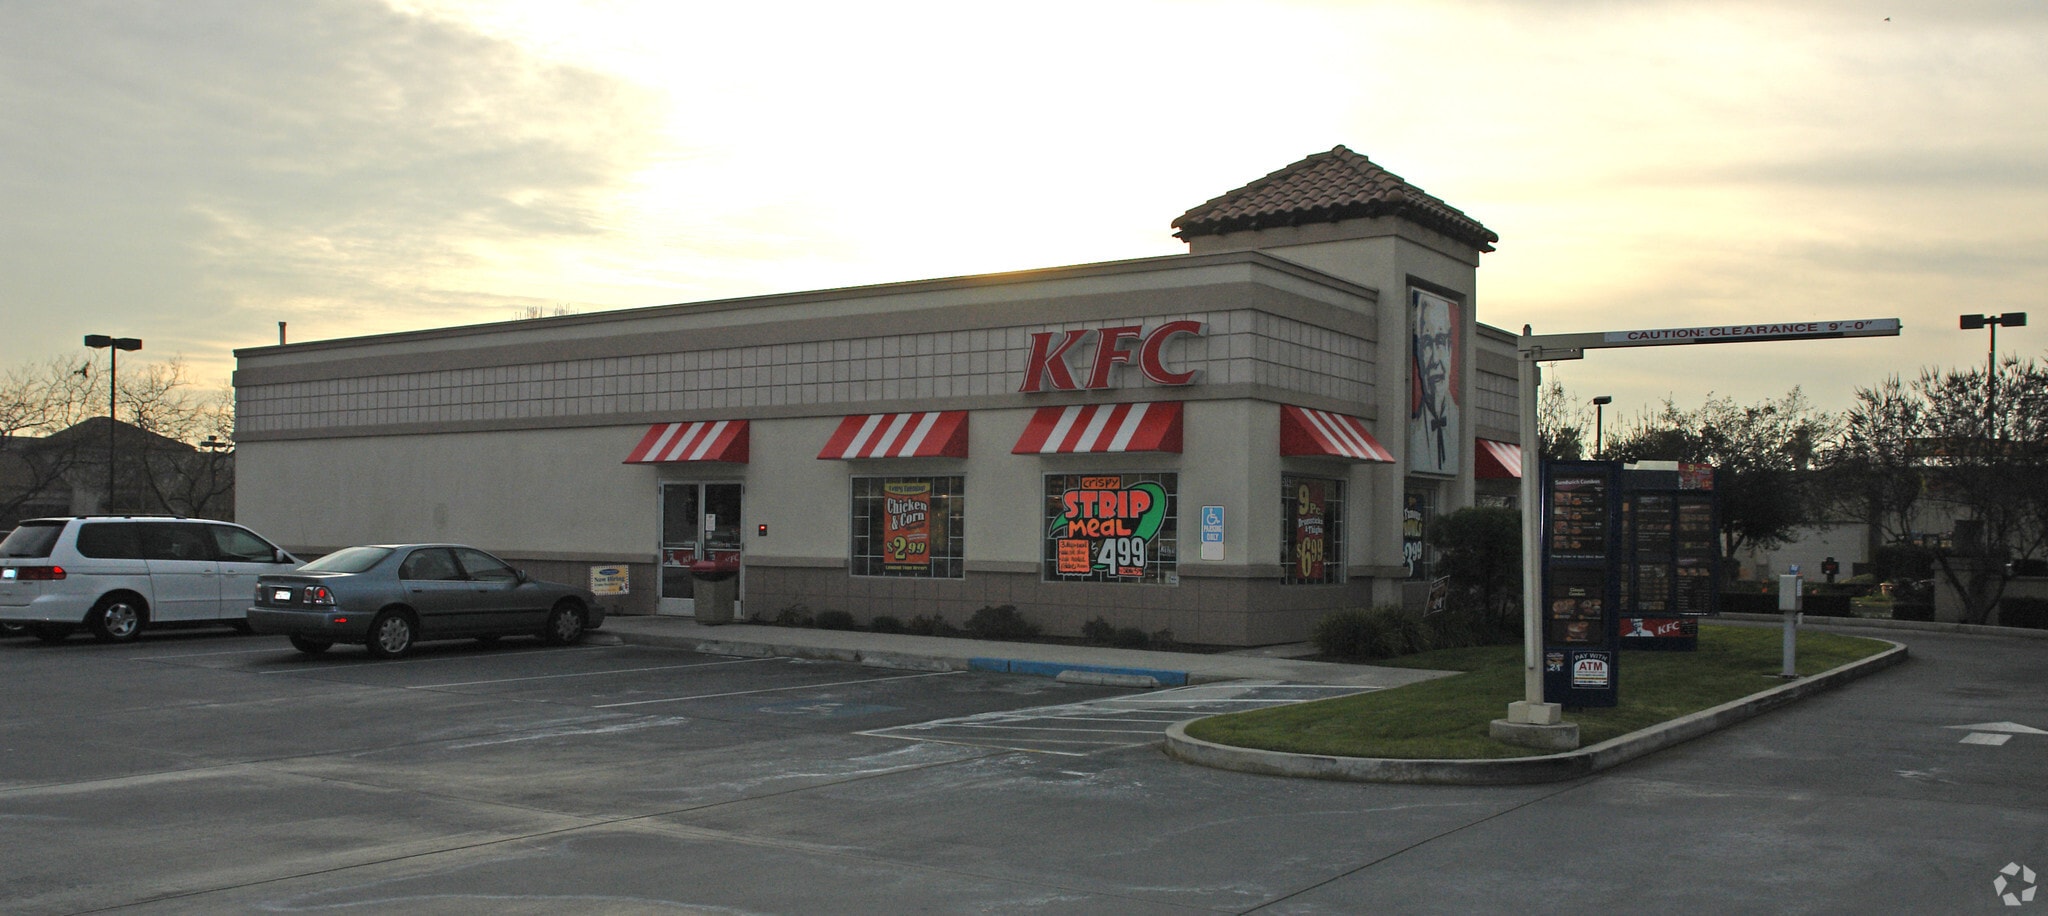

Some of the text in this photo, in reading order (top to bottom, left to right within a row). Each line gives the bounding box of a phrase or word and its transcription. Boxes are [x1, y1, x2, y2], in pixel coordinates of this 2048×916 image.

[1627, 329, 1705, 341] CAUTION:
[1709, 323, 1818, 336] CLEARANCE
[1018, 319, 1208, 393] KFC
[1083, 477, 1119, 488] crispy
[887, 497, 928, 515] Chicken
[1063, 489, 1151, 519] STRIP
[1298, 484, 1310, 516] 9
[891, 514, 899, 530] &
[900, 511, 925, 527] Corn
[1657, 620, 1681, 636] KFC
[1574, 653, 1588, 661] PAY
[1589, 653, 1609, 662] WITH
[1579, 661, 1603, 671] ATM
